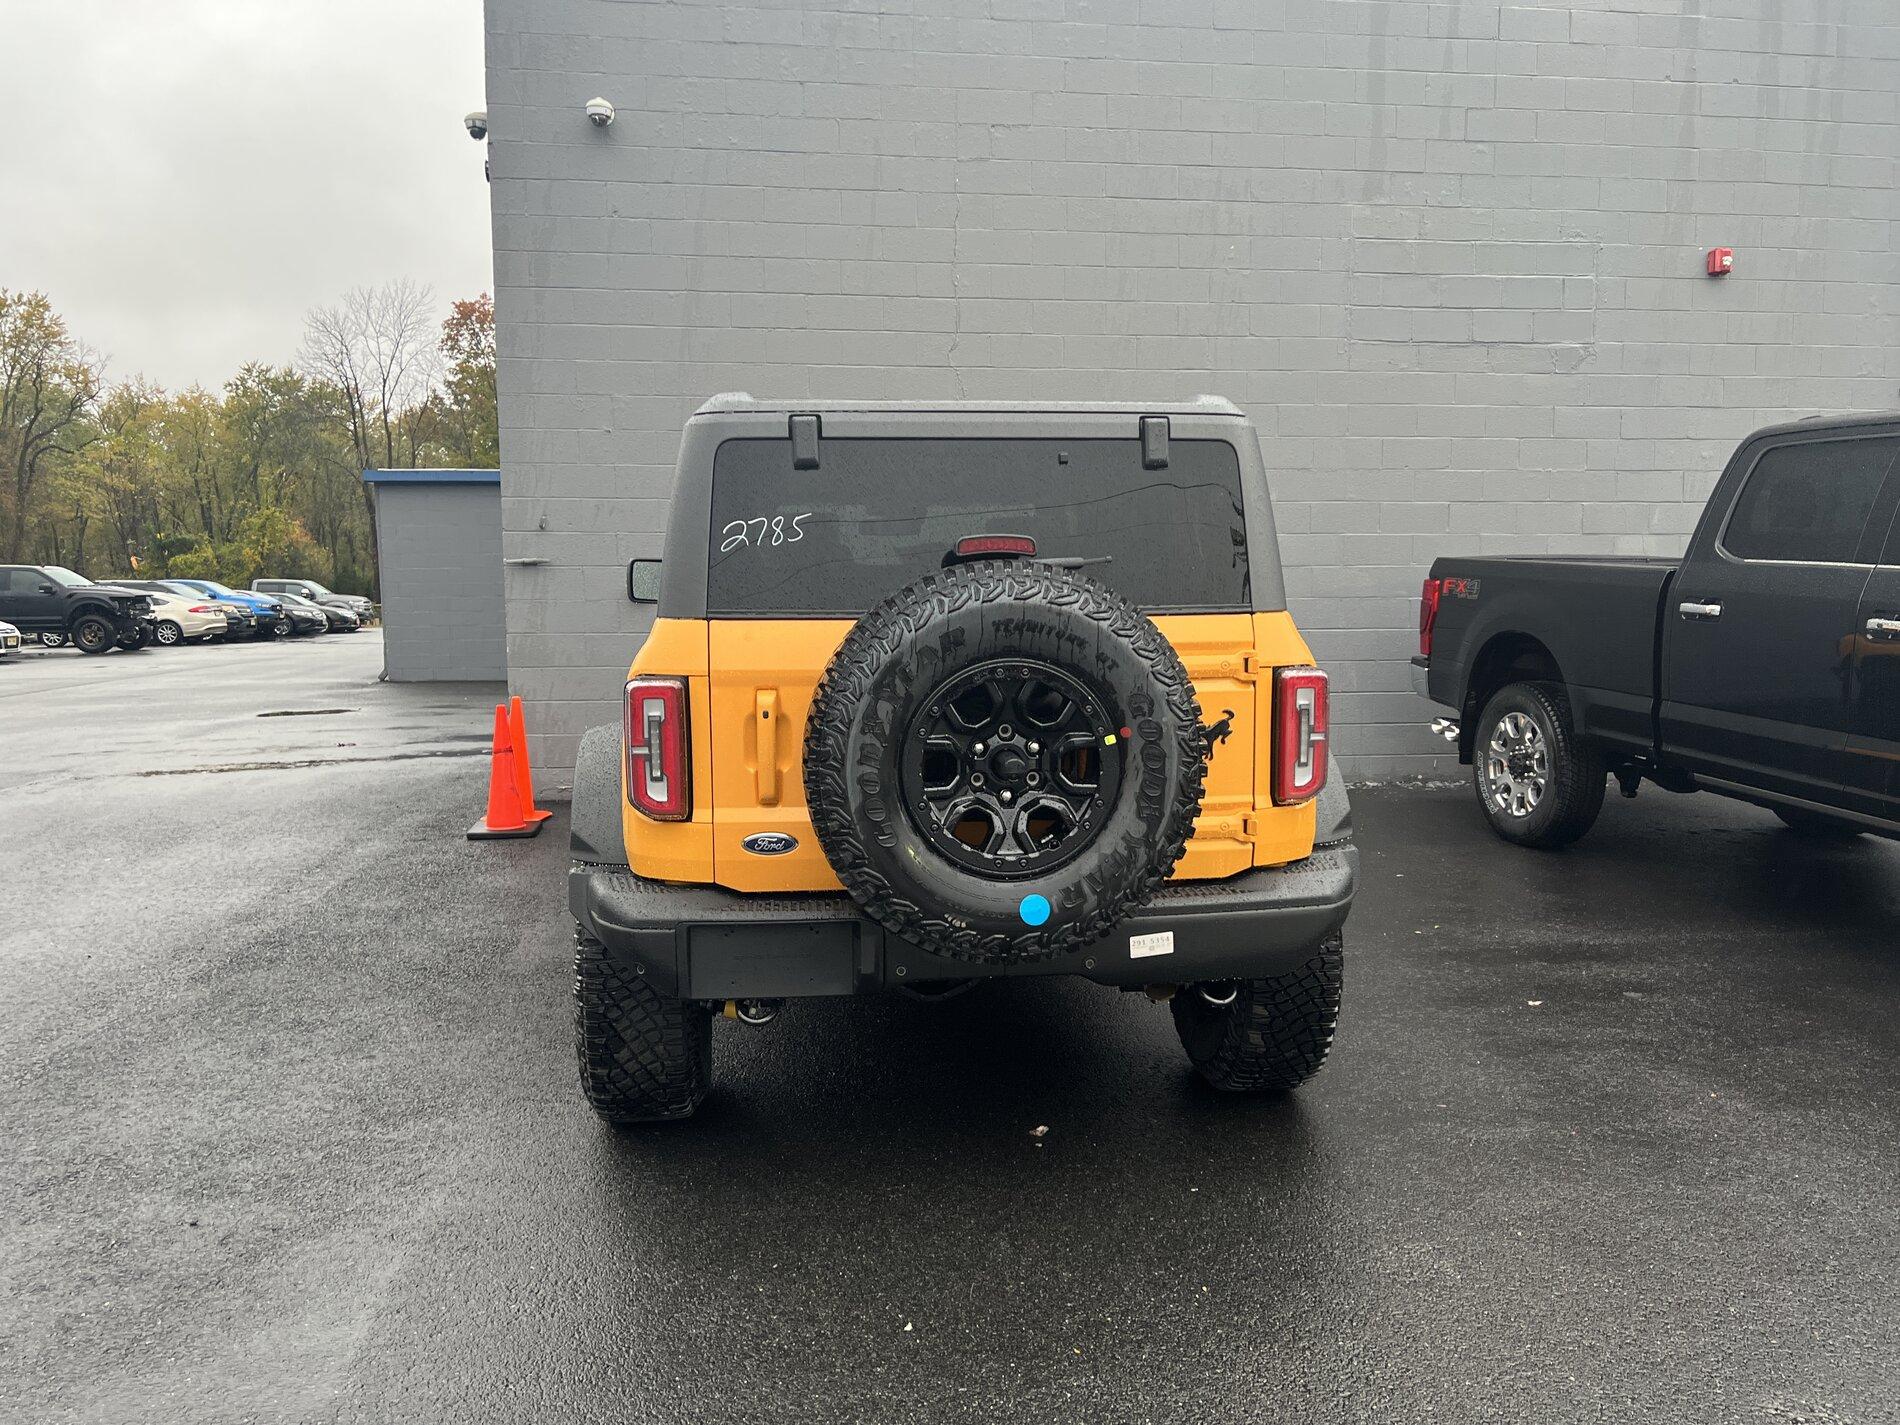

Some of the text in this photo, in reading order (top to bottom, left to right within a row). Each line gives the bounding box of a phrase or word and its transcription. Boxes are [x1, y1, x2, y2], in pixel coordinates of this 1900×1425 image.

[720, 512, 813, 553] 2785
[1442, 577, 1481, 596] FX4
[754, 837, 785, 851] Ford
